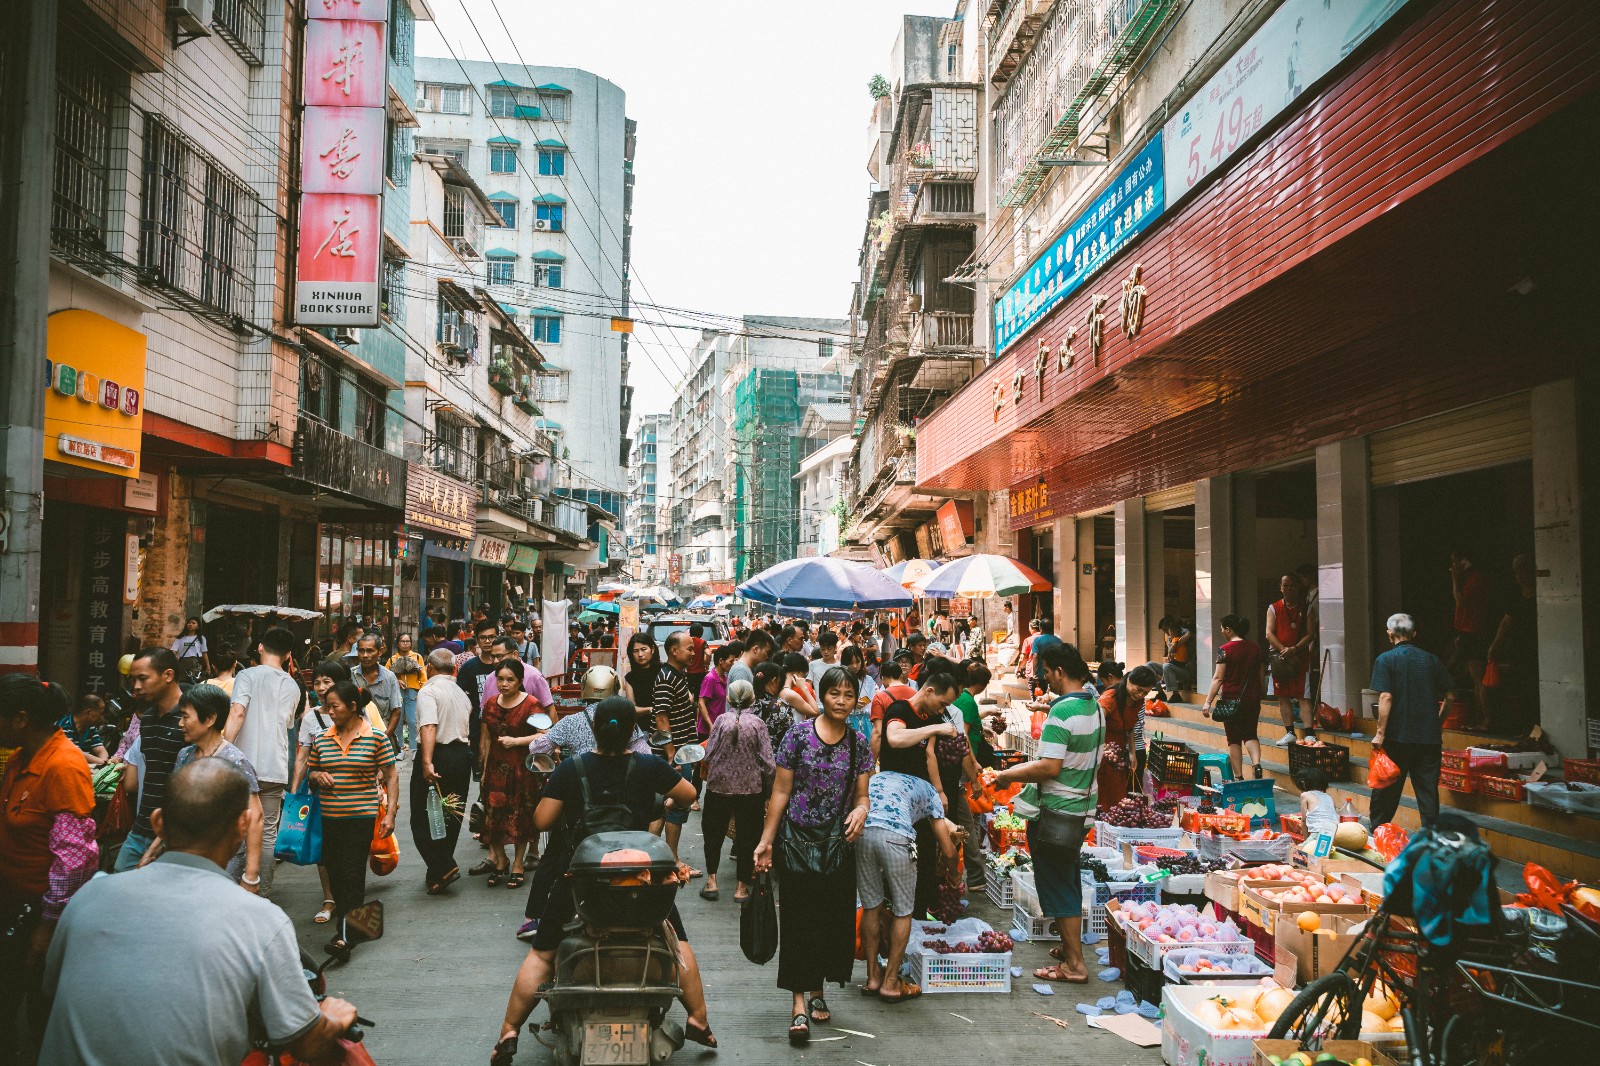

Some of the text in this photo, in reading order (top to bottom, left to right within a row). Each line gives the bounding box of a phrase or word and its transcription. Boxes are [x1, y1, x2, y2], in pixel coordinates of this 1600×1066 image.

[1098, 186, 1123, 222] 国家重点
[1124, 156, 1154, 196] 国有公办
[1114, 185, 1155, 239] 欢迎报读
[300, 304, 374, 314] BOOKSTORE
[312, 291, 362, 301] XINHUA
[86, 526, 113, 693] 步步高教育电子
